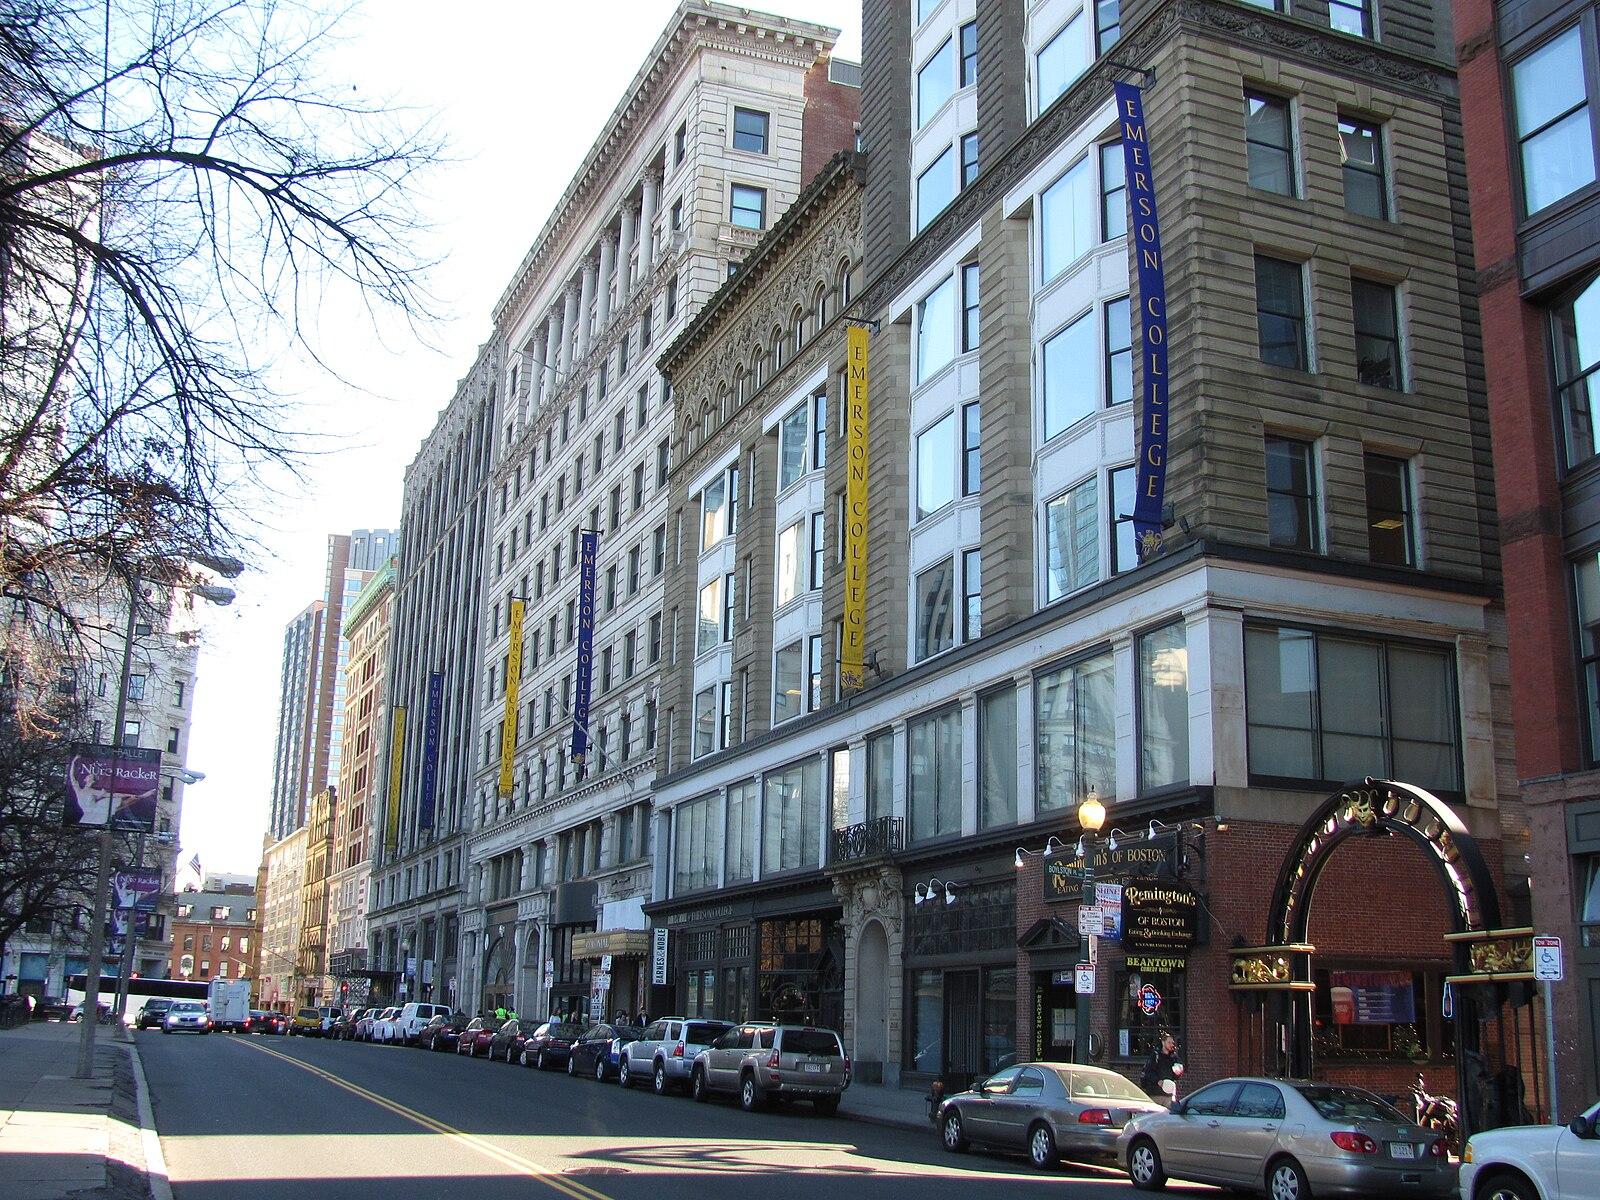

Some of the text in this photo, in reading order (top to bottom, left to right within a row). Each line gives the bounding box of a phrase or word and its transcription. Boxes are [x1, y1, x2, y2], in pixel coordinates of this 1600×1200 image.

[1124, 100, 1163, 498] EMERSON COLLEGE
[849, 346, 866, 648] EMERSON COLLEGE
[582, 541, 594, 629] EMERSON
[504, 609, 521, 773] EMERSON COLLEGE
[429, 680, 439, 746] EMERSON
[1127, 848, 1166, 863] BOSTON
[1048, 865, 1072, 876] BOYLSTON
[1057, 884, 1079, 894] EATING
[1124, 886, 1197, 906] Remington's
[1137, 916, 1185, 927] OF BOSTON
[1126, 956, 1186, 968] BEANTOWN
